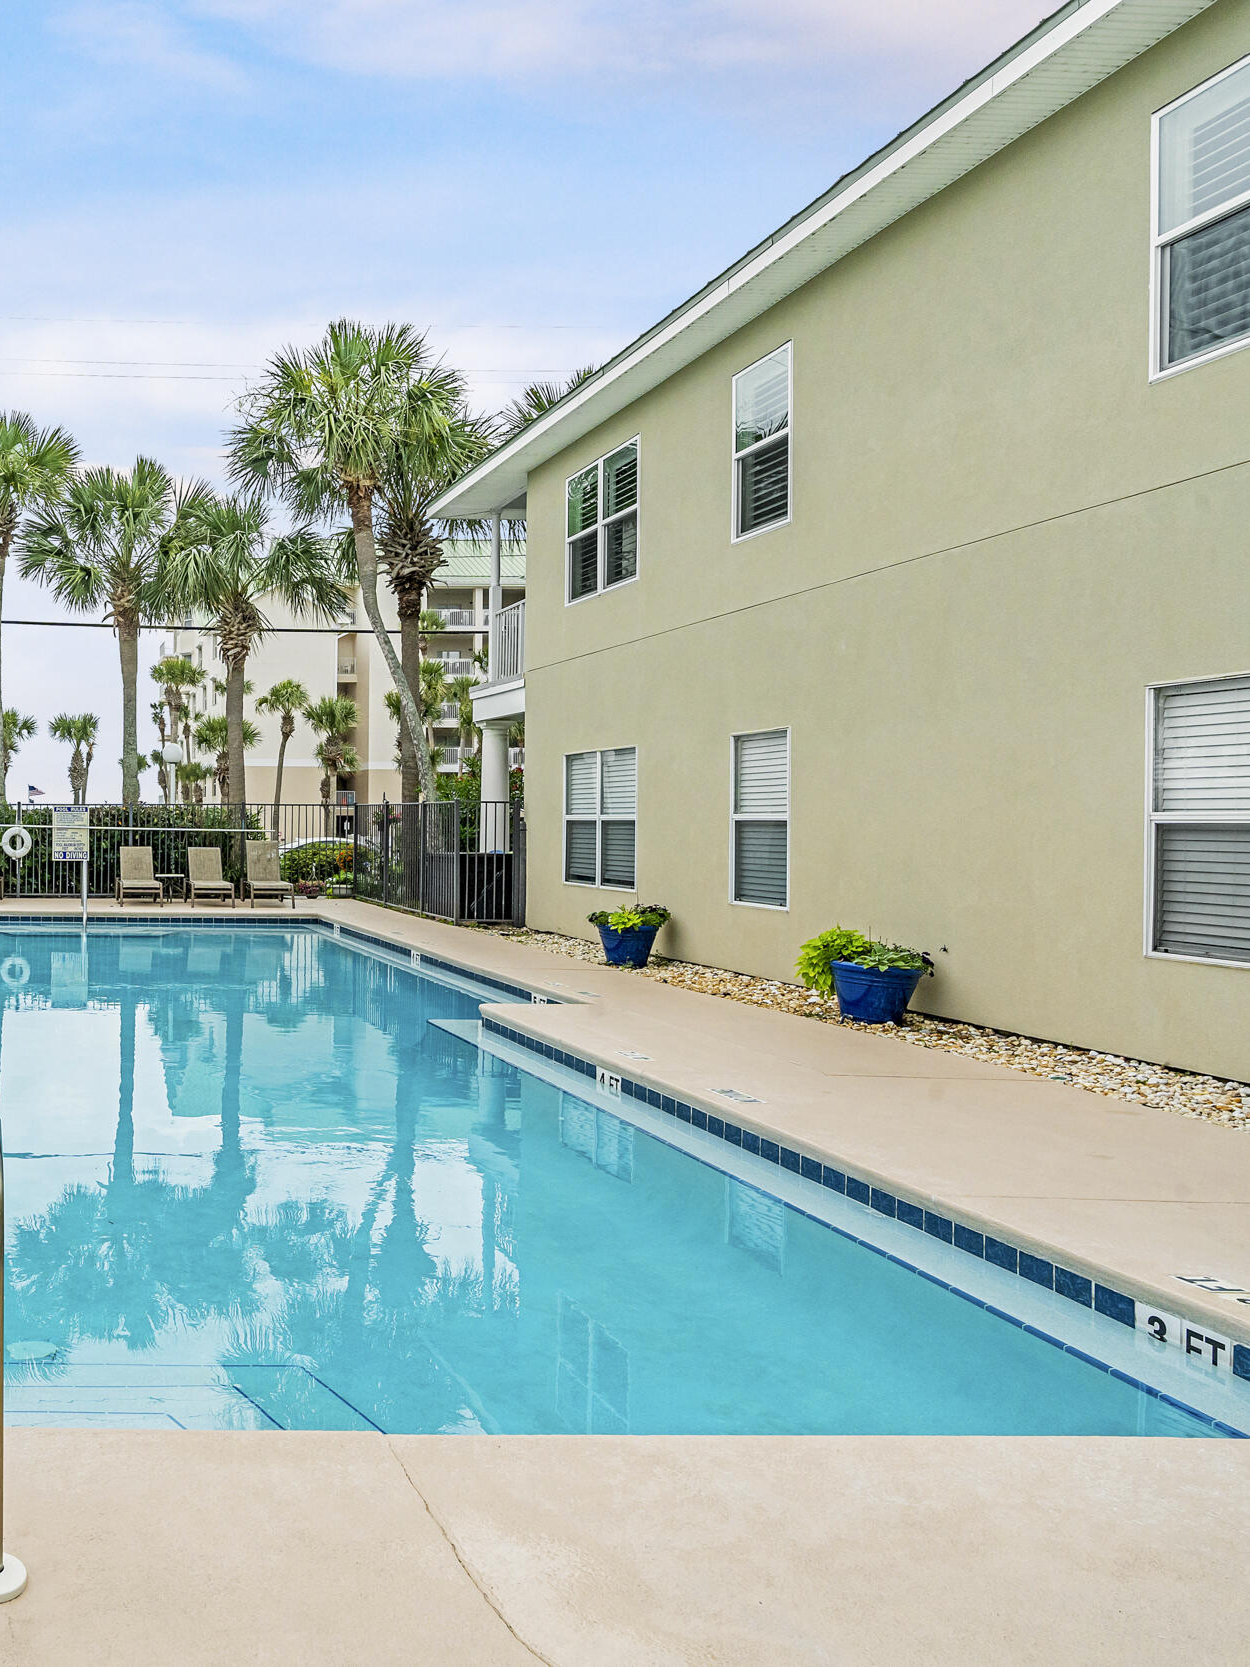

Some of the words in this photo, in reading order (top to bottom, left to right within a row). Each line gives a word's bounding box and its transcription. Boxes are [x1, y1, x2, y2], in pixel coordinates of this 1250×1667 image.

[54, 851, 64, 859] NO
[65, 851, 87, 859] DIVING
[609, 1076, 620, 1090] FT
[1148, 1316, 1167, 1342] 3
[1186, 1328, 1226, 1367] FT
